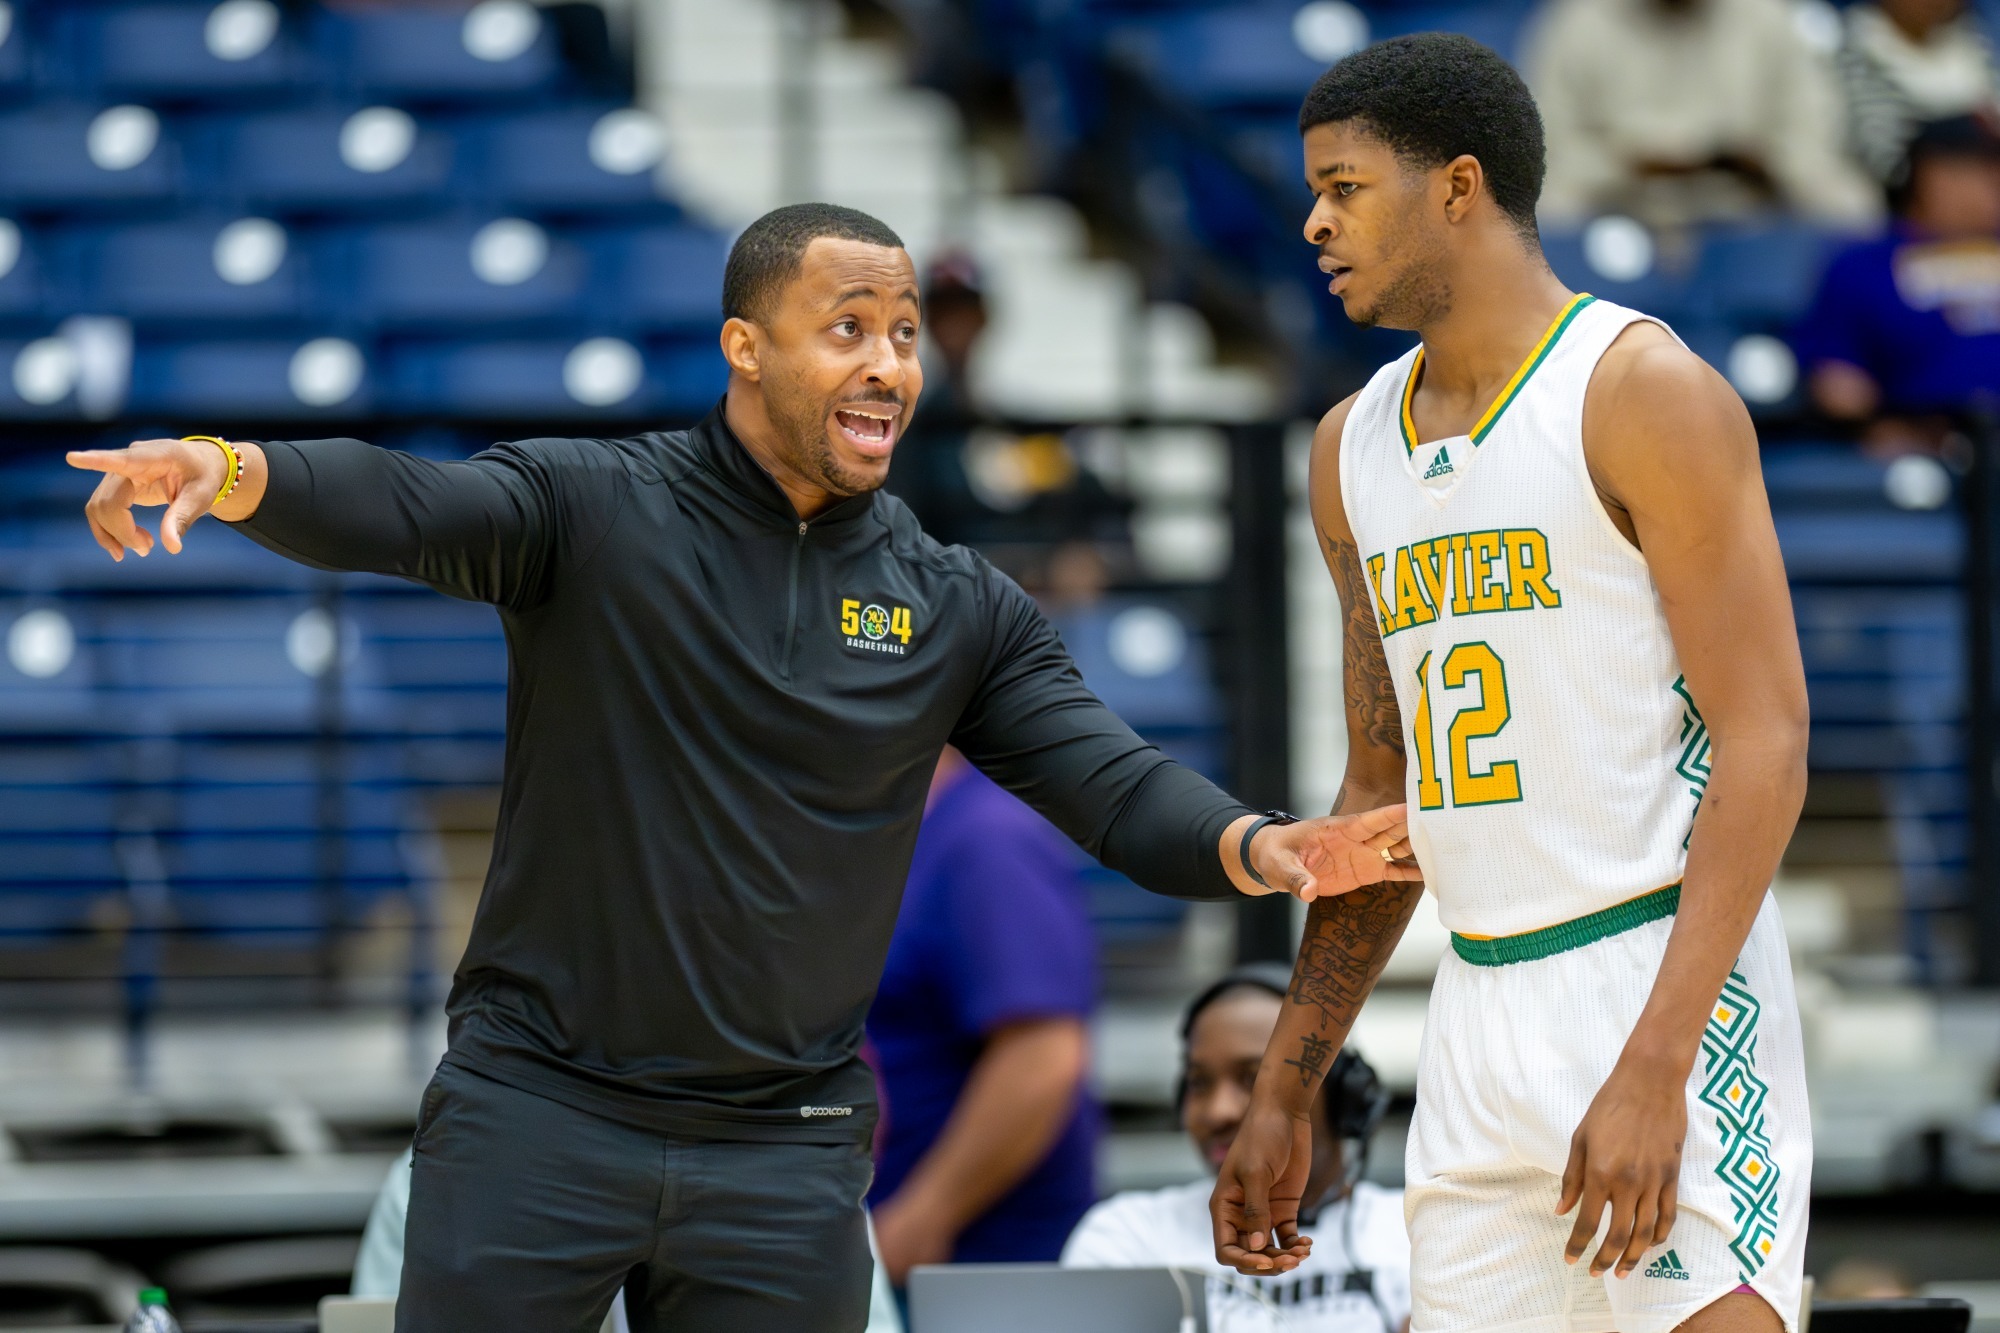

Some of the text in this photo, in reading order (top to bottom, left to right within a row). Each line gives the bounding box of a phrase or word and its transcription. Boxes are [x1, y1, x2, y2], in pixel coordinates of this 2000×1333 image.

[1423, 463, 1454, 479] adidas
[1366, 528, 1562, 639] XAVIER
[846, 637, 905, 655] BASKETBALL
[1413, 640, 1523, 811] 12
[1644, 1267, 1690, 1280] adidas
